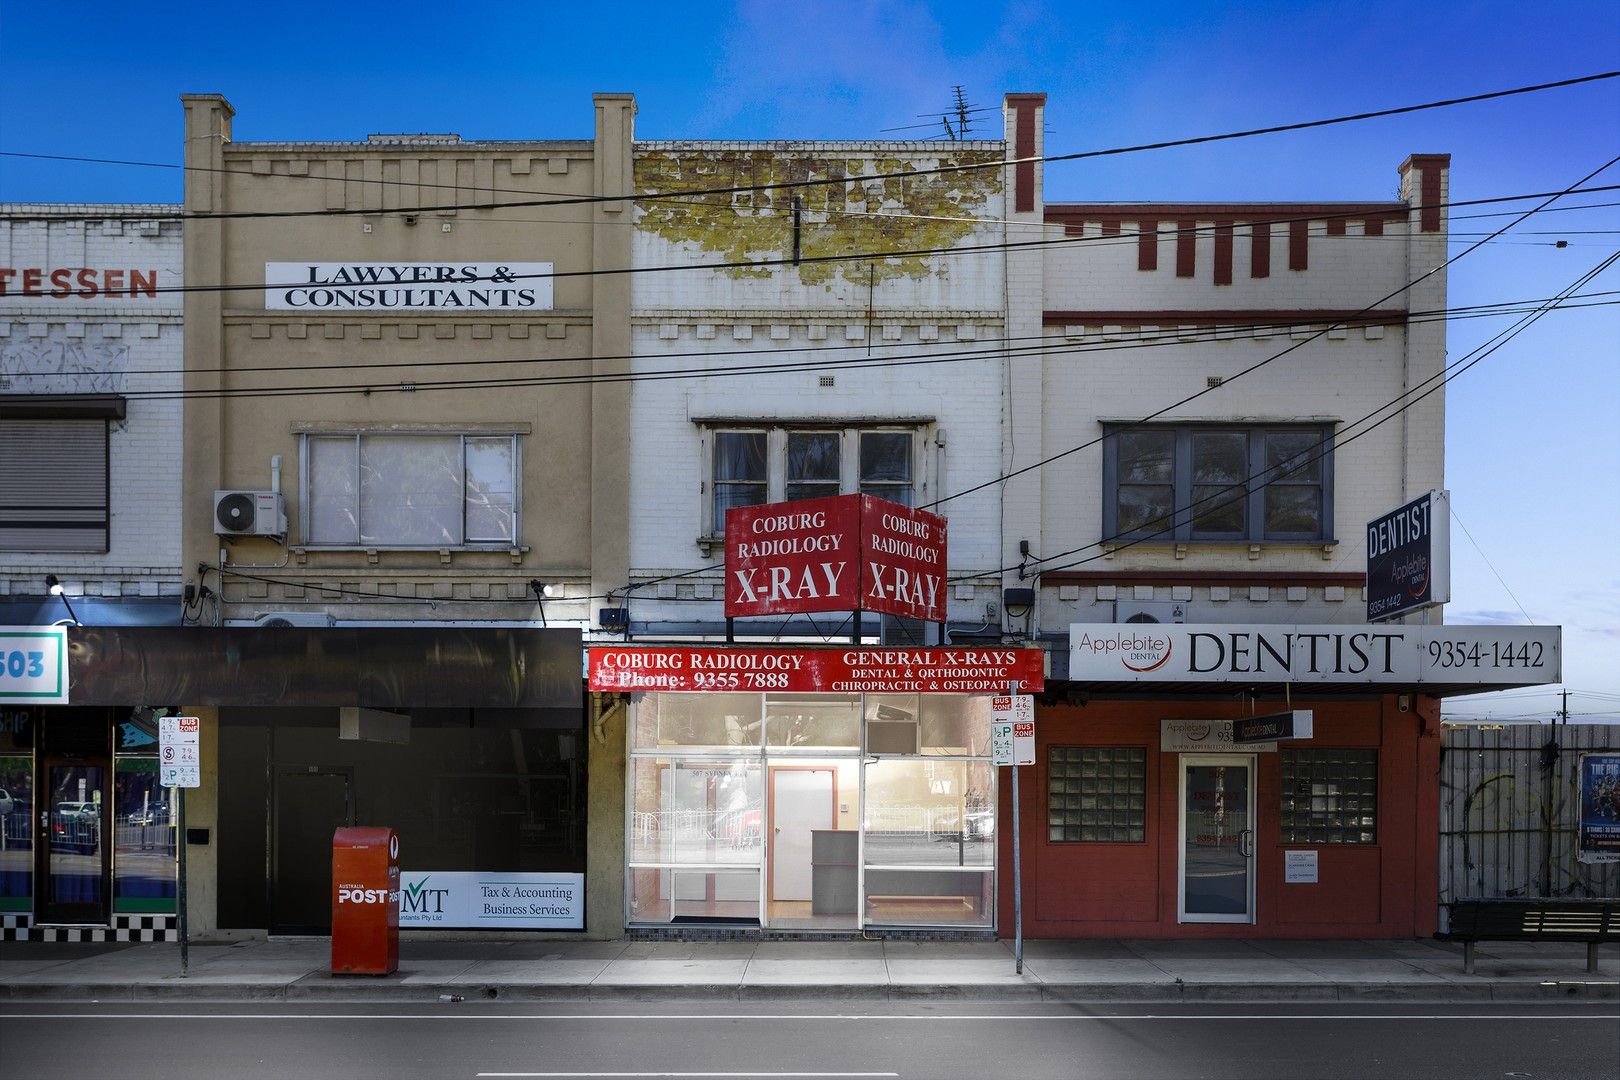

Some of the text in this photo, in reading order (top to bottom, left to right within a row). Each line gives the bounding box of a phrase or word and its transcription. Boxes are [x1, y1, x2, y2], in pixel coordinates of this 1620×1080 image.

[307, 266, 517, 284] LAWYERS &
[284, 289, 536, 307] CONSULTANTS
[752, 512, 825, 534] COBURG
[882, 513, 930, 540] COBURG
[1369, 500, 1429, 559] DENTIST
[738, 534, 843, 559] RADIOLOGY
[871, 534, 939, 565] RADIOLOGY
[1391, 554, 1427, 584] Applebite
[734, 561, 847, 604] X-RAY
[869, 561, 941, 609] X-RAY
[1078, 632, 1164, 655] Applebite
[603, 653, 804, 670] COBURG RADIOLOGY
[843, 651, 1016, 666] GENERAL X-RAYS
[1130, 653, 1161, 661] DENTAL
[1187, 632, 1404, 674] DENTIST
[1428, 640, 1544, 668] 9354-1442
[619, 671, 789, 688] Phone: 9355 7888
[852, 667, 1008, 679] DENTAL & ORTHODONTIC
[832, 681, 923, 691] CHIROPRACTIC
[929, 680, 939, 690] &
[1002, 726, 1011, 737] P
[338, 889, 388, 904] POST
[481, 886, 573, 901] Tax & Accounting
[421, 914, 431, 922] Pty
[484, 903, 570, 915] Business Services
